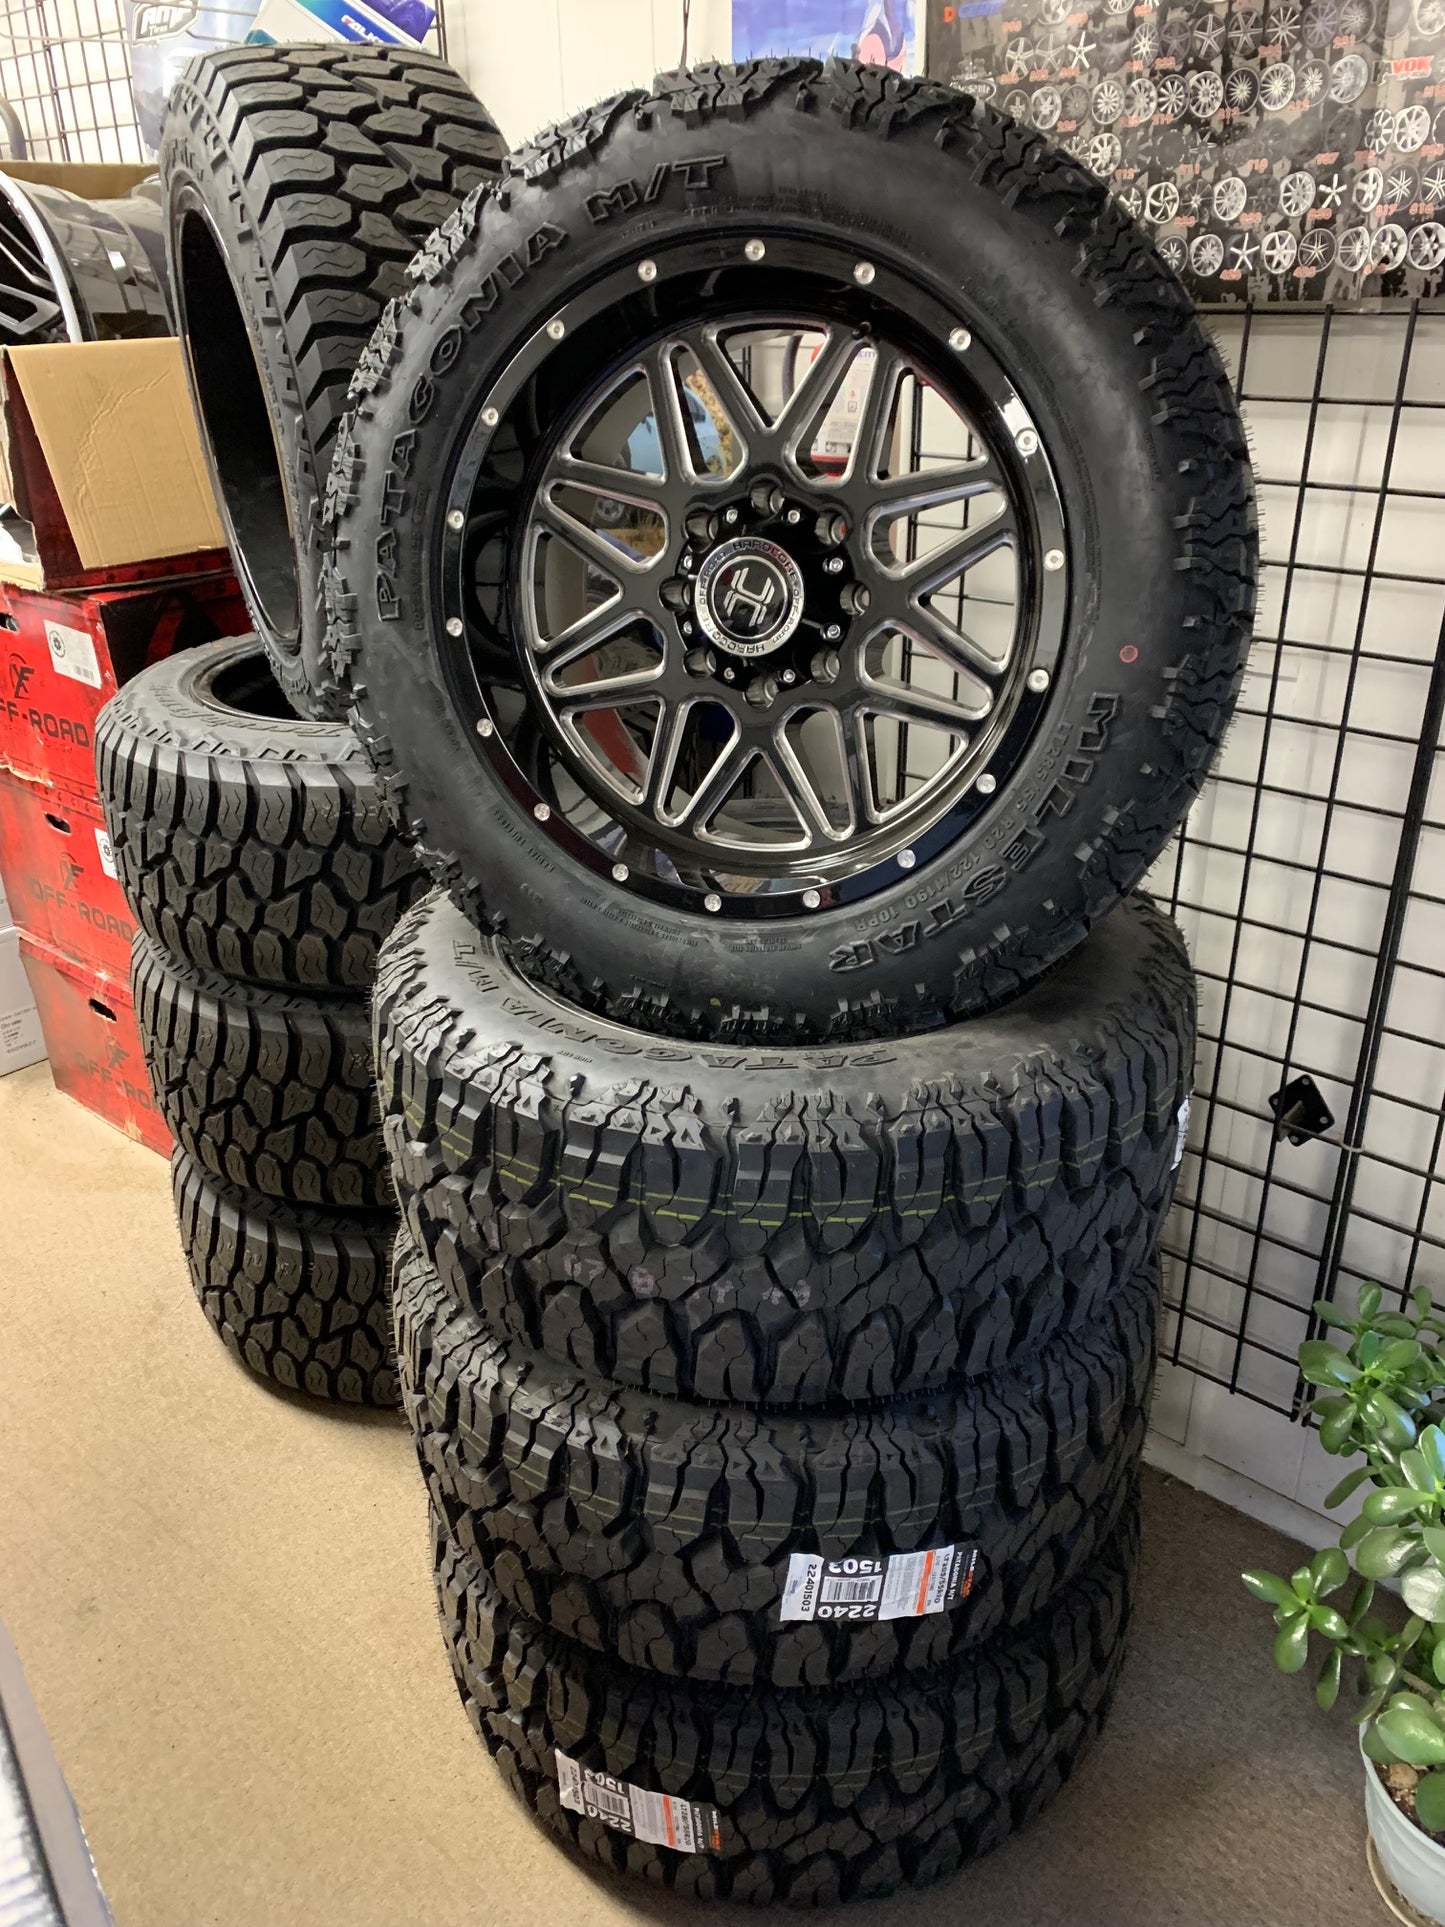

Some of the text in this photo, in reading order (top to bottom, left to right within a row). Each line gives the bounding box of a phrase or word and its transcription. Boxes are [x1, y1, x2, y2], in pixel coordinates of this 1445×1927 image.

[340, 14, 384, 43] FALK
[375, 154, 727, 622] PATAGONIA M/T
[829, 690, 1120, 973] MILESTAR
[854, 906, 900, 932] 10PR
[451, 938, 900, 1071] PATAGONIA M/T
[828, 1558, 882, 1575] 1503
[801, 1563, 817, 1612] 22401503
[818, 1604, 877, 1619] 2240
[586, 1803, 632, 1832] 2240
